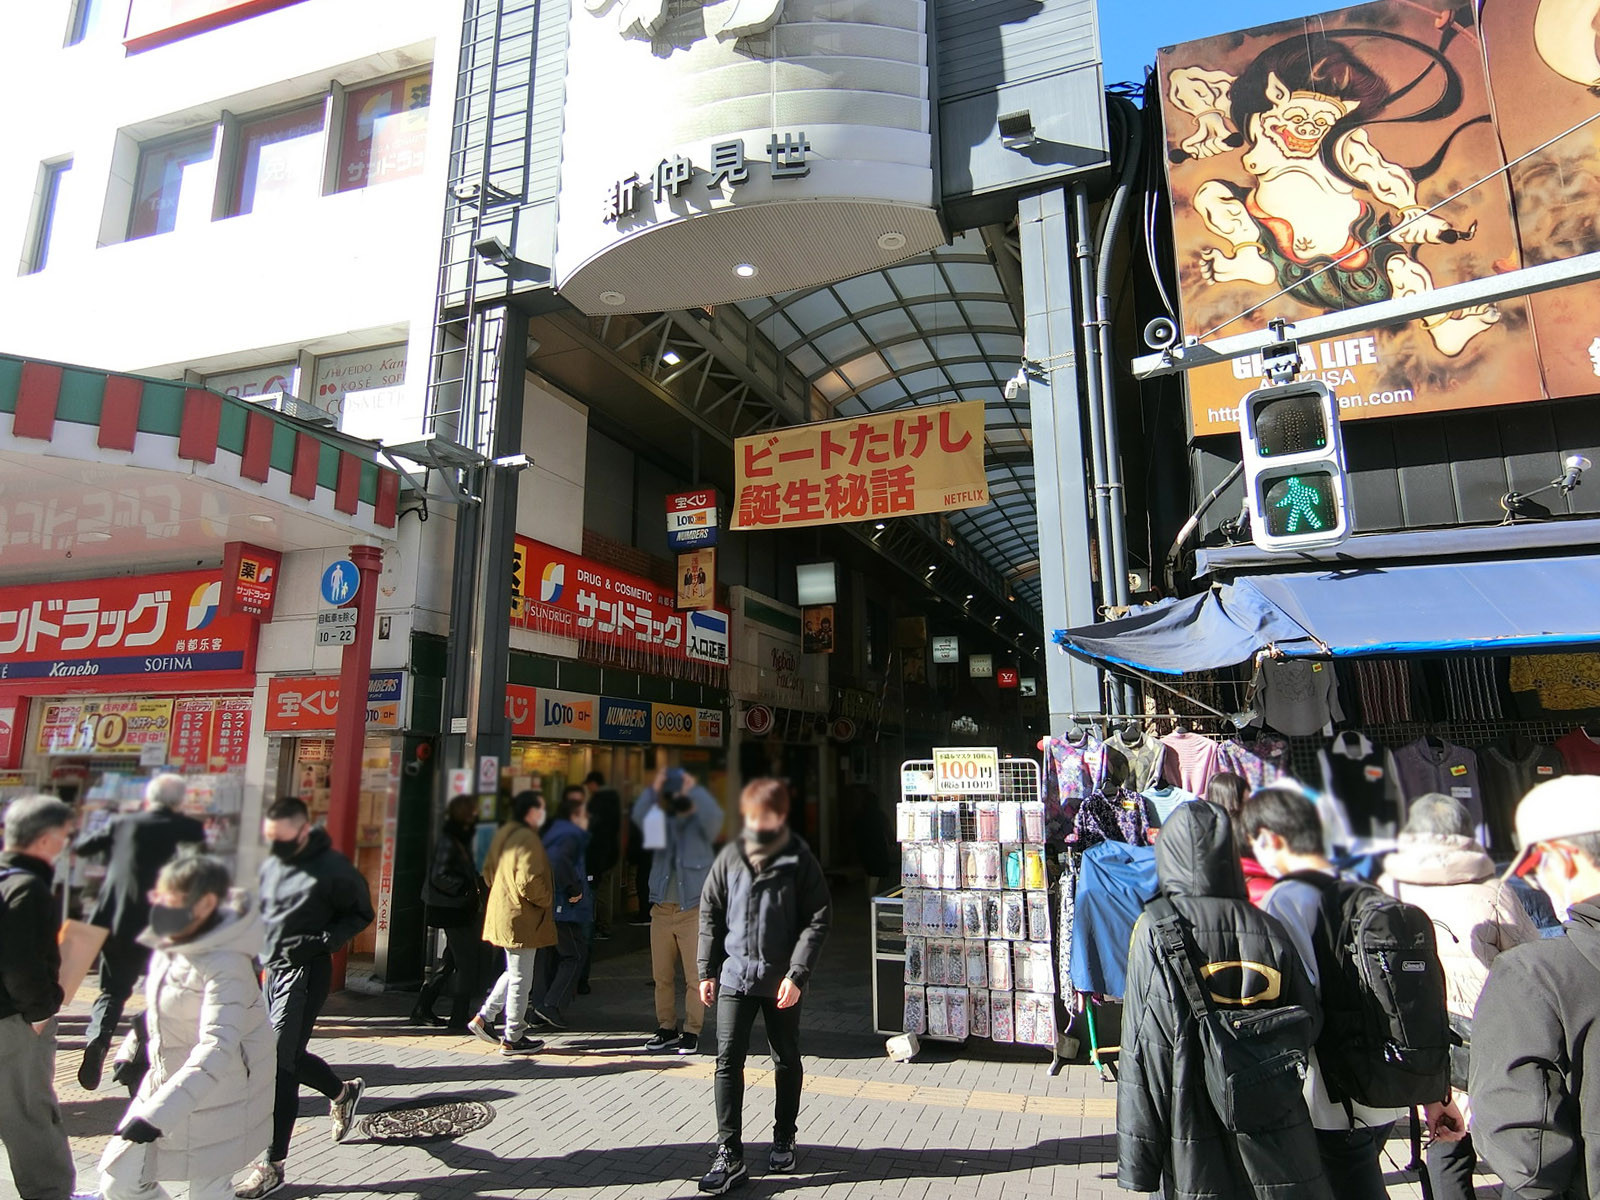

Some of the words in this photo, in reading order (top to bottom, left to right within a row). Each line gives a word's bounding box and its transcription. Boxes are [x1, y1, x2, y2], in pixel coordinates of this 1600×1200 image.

[603, 131, 811, 225] 新仲見世
[1319, 336, 1377, 369] LIFE
[321, 363, 374, 380] SHISEIDO
[340, 379, 372, 392] KOSÉ
[744, 411, 973, 479] ビートたけし
[675, 494, 707, 510] 宝くじ
[738, 464, 915, 527] 誕生秘話
[944, 489, 984, 506] NETFLIX
[675, 528, 709, 542] NUMBERS
[240, 561, 257, 580] 薬
[236, 586, 271, 601] サンドラッグ
[577, 568, 602, 588] DRUG
[605, 578, 612, 590] &
[614, 582, 653, 603] COSMETIC
[318, 612, 356, 624] 自転車を除く
[530, 605, 572, 625] SUNDRUG
[577, 589, 682, 648] サンドラッグ
[175, 638, 223, 652] 尚都乐客
[691, 635, 726, 661] 入口正面
[49, 661, 100, 677] Kanebo
[144, 656, 193, 672] SOFINA
[277, 690, 340, 718] 宝くじ
[544, 698, 573, 727] LOTO
[578, 711, 591, 721] ロト
[605, 706, 647, 729] NUMBERS
[656, 710, 692, 732] toto
[79, 713, 128, 749] 10
[941, 760, 992, 779] 100円
